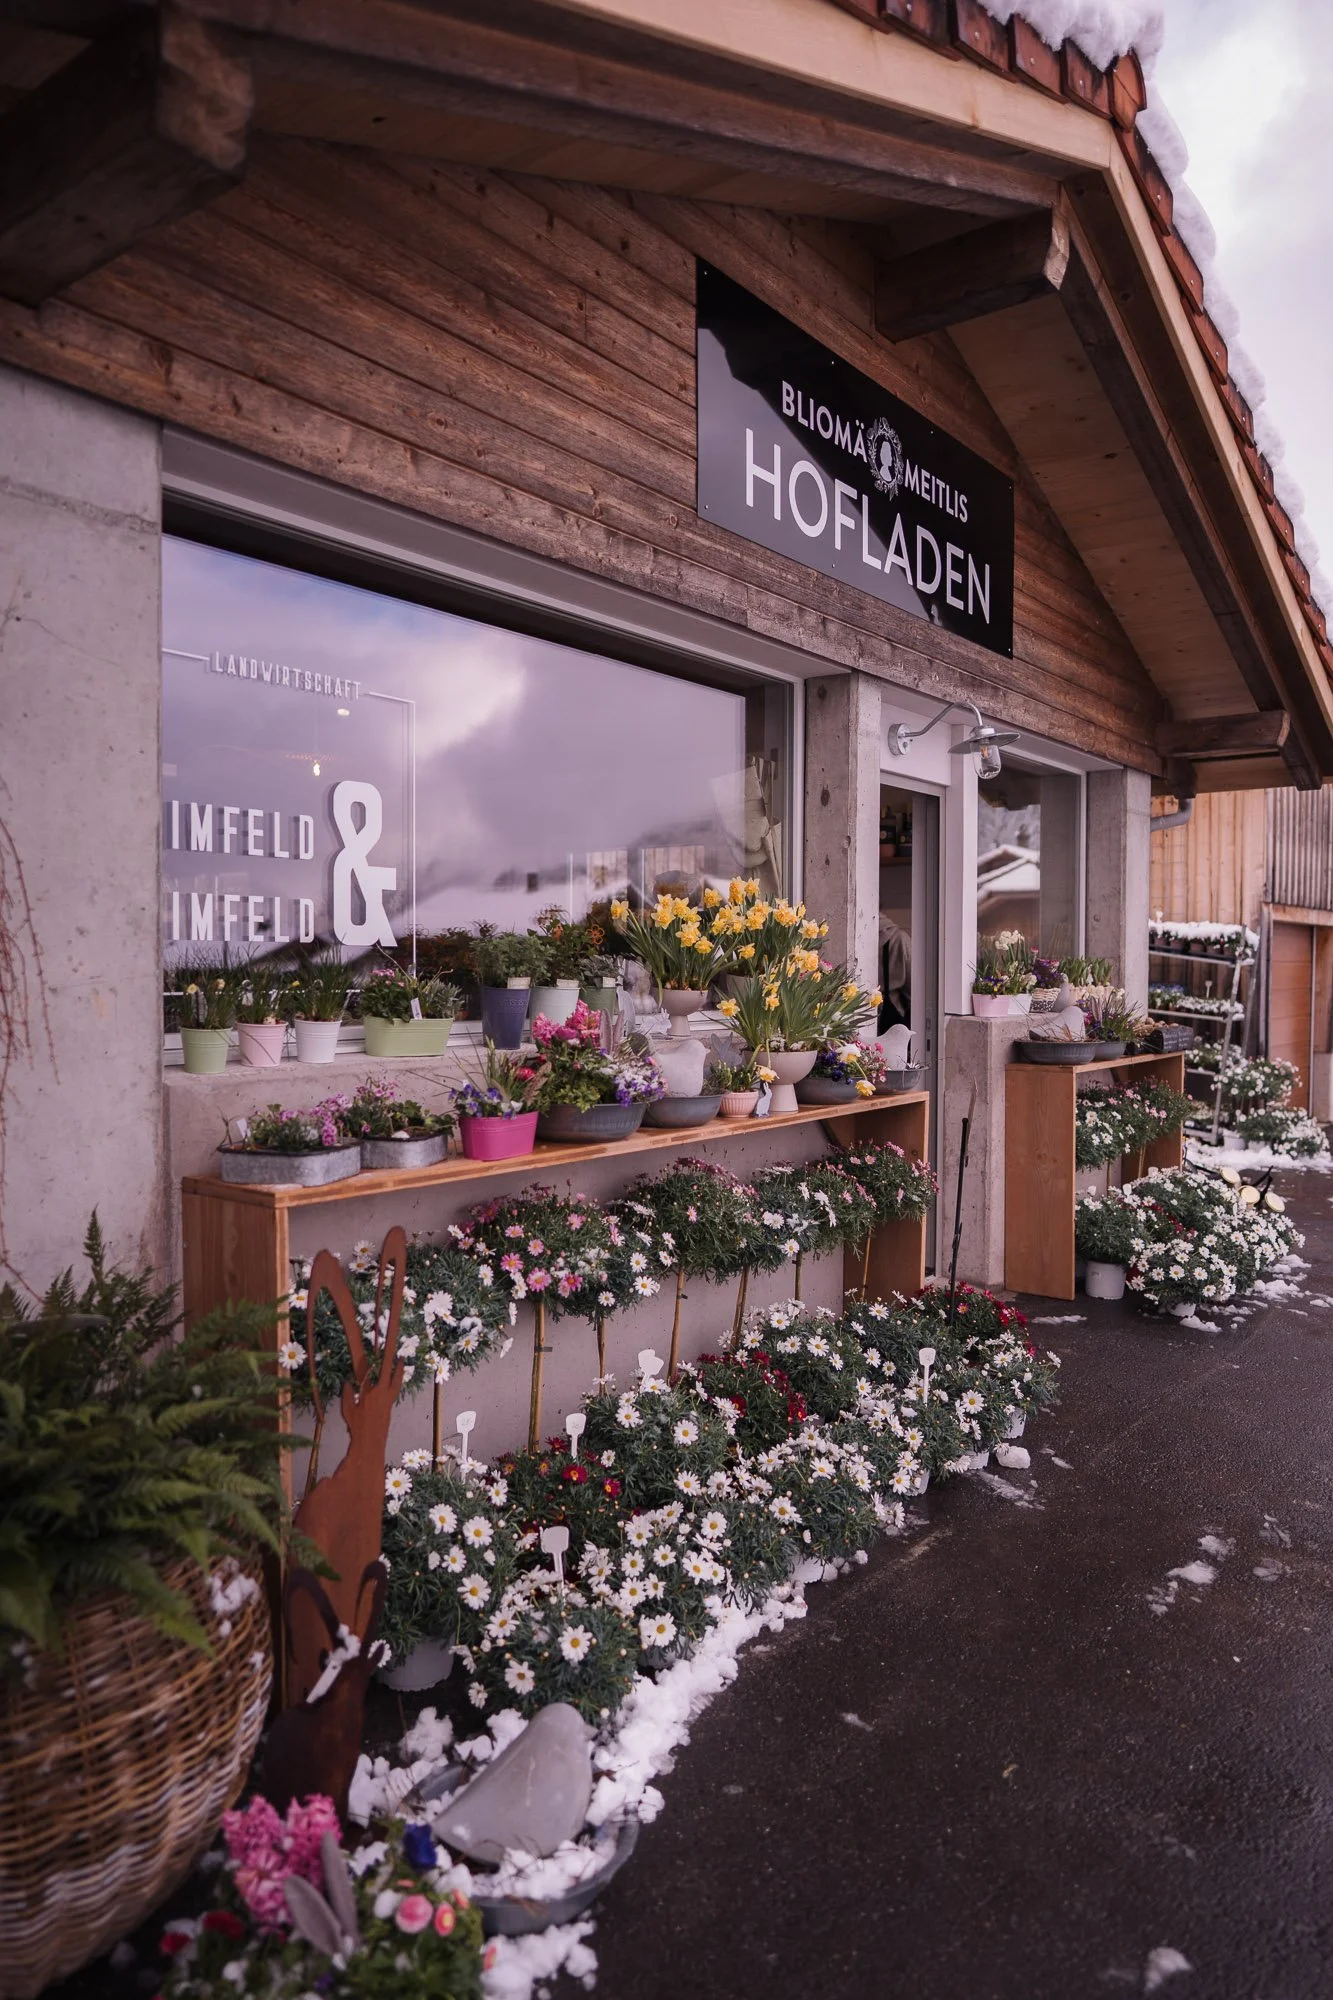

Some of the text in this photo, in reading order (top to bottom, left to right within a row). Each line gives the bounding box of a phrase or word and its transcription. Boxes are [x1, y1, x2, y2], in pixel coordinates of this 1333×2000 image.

[781, 380, 969, 523] BLIOMÄ MEITLIS
[745, 428, 990, 624] HOFLADEN
[216, 651, 361, 699] LANDWIRTSCHAFT
[172, 800, 314, 860] IMFELD
[333, 780, 397, 946] &
[172, 892, 315, 944] IMFELD
